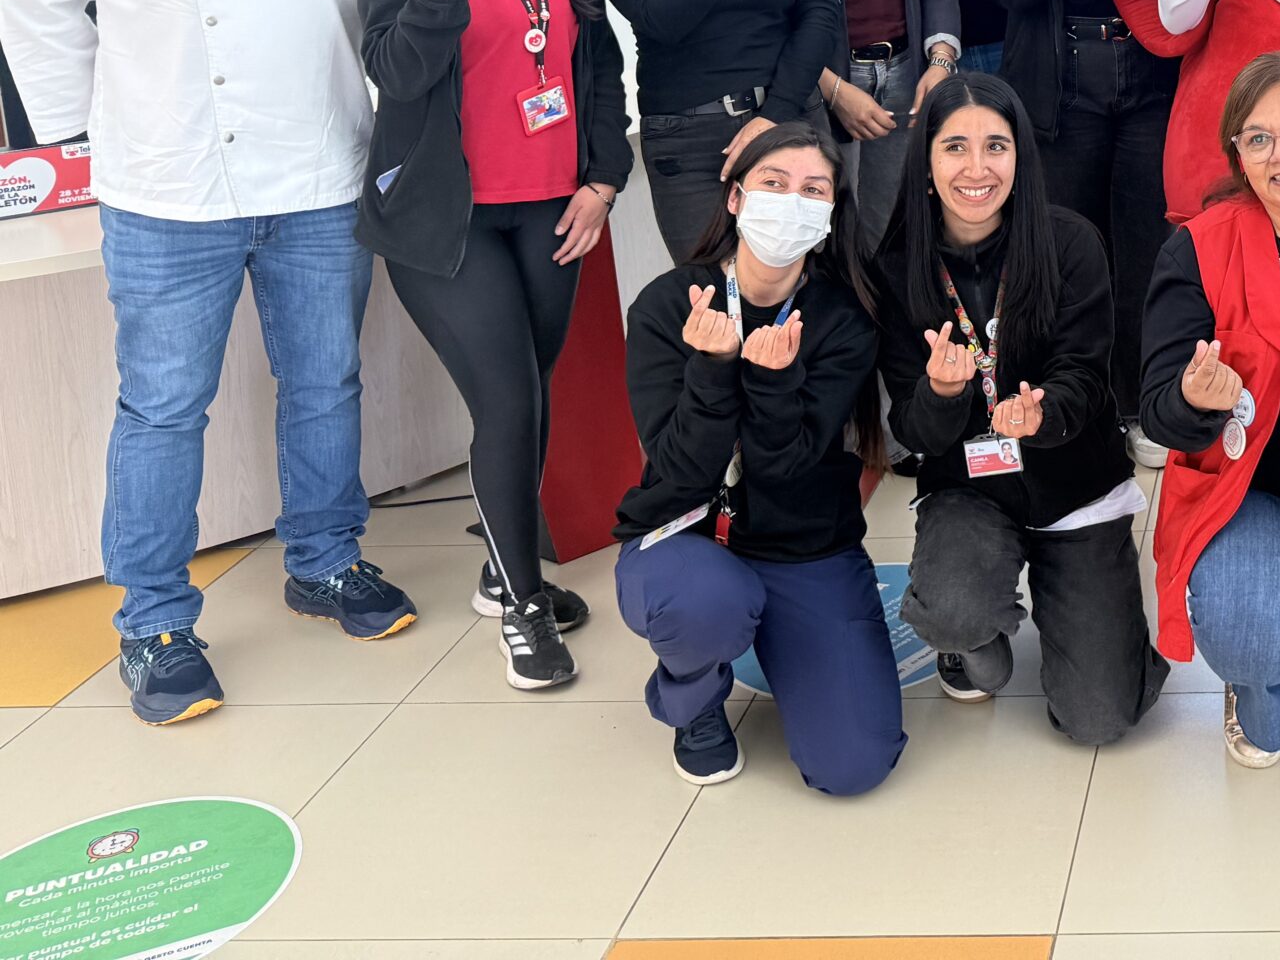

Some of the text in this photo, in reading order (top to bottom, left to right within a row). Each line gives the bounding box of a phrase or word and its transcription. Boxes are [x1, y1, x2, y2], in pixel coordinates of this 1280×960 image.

[5, 839, 209, 903] PUNTUALIDAD
[18, 855, 193, 908] Cada minuto importa
[95, 888, 132, 904] hora
[136, 879, 165, 893] nos
[169, 861, 231, 887] permite
[96, 890, 160, 913] máximo
[164, 872, 224, 893] nuestro
[28, 903, 200, 960] puntual es cuidar el
[42, 900, 159, 937] tiempo juntos.
[89, 922, 170, 949] de todos.
[176, 939, 213, 952] CUENTA
